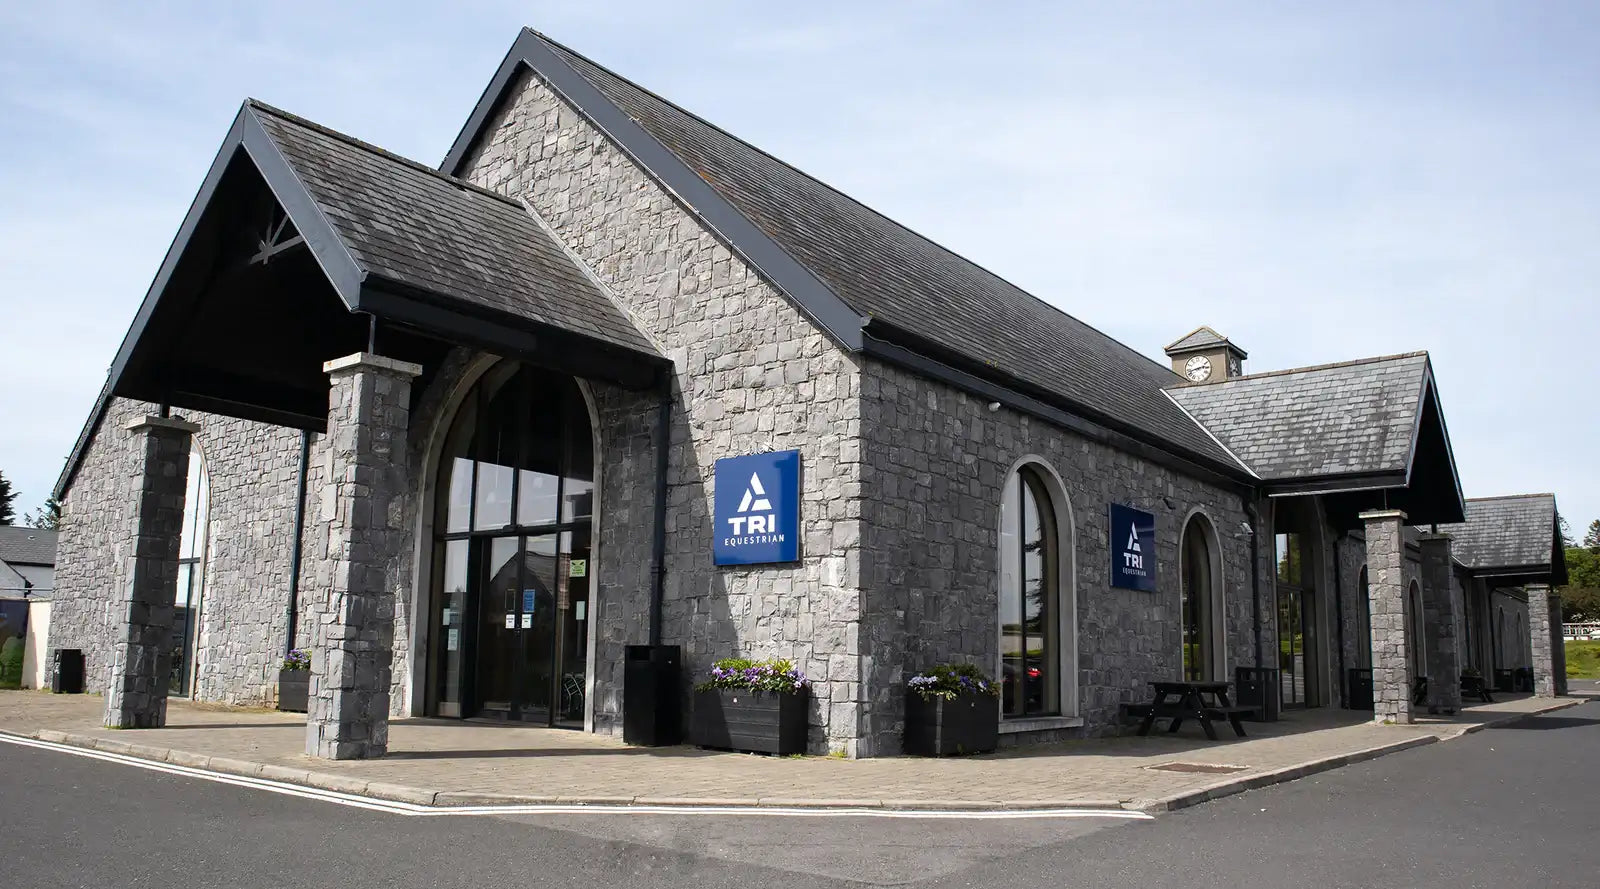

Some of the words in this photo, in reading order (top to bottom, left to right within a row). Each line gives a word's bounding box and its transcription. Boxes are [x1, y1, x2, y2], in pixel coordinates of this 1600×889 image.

[728, 514, 775, 535] TRI
[725, 534, 784, 546] EQUESTRIAN
[1123, 552, 1143, 568] TRI
[1123, 567, 1146, 576] EQUESTRIAN
